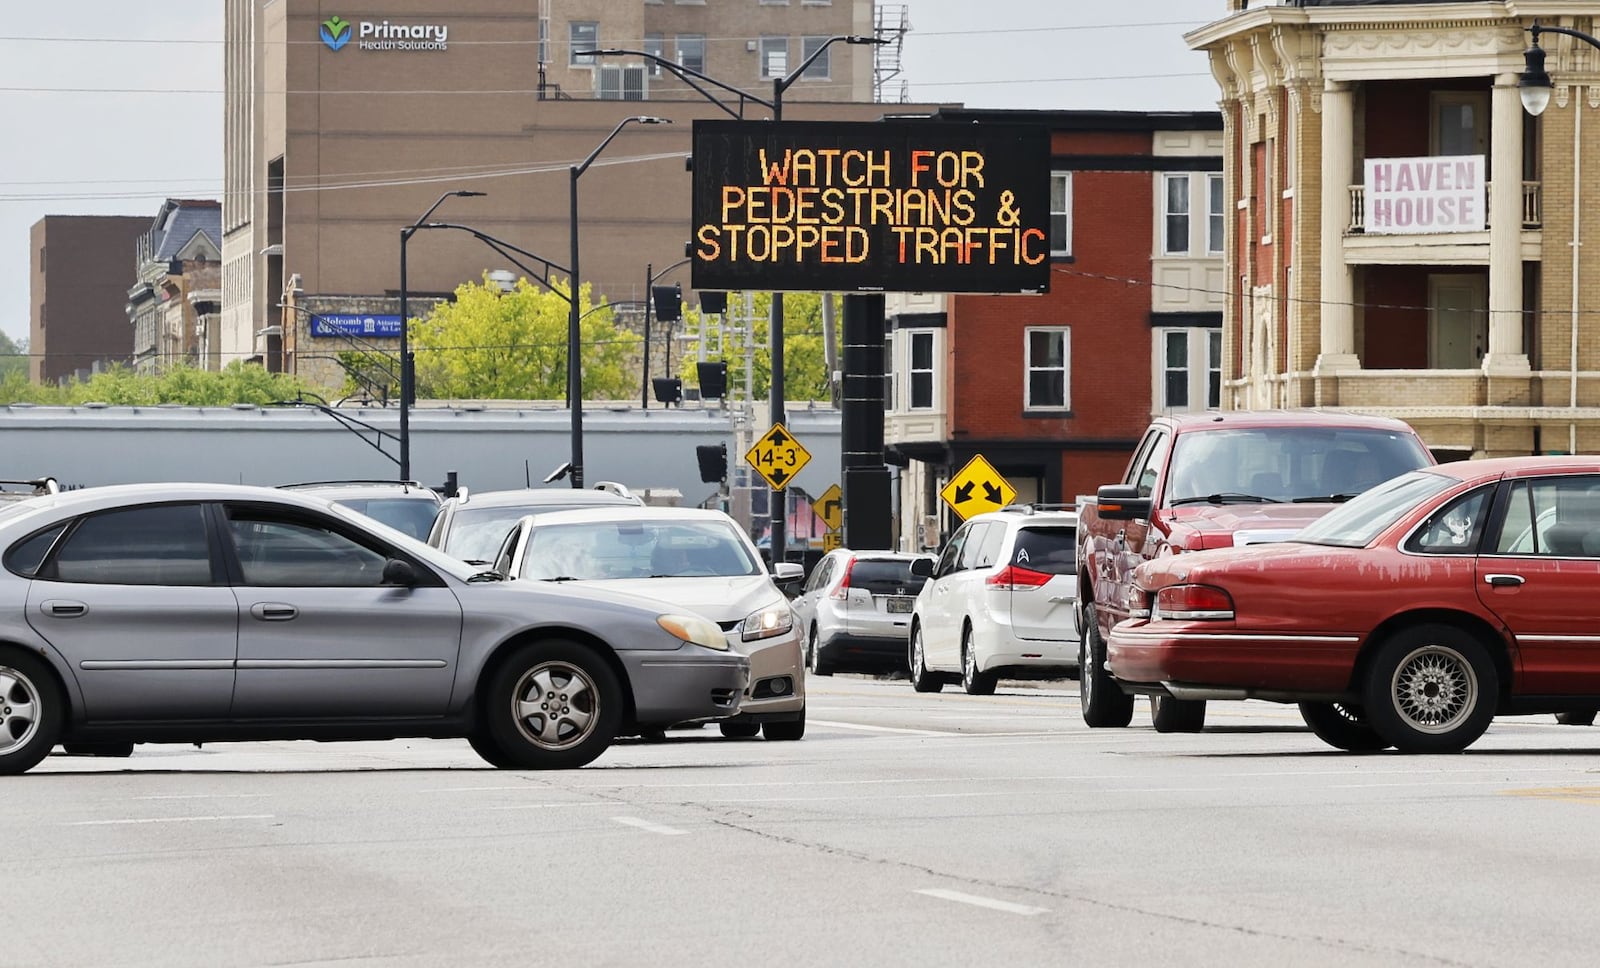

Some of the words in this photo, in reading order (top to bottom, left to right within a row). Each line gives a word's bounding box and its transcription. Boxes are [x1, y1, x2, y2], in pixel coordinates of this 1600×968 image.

[360, 21, 447, 42] Primary
[360, 40, 395, 50] Health
[398, 40, 447, 50] Solutions
[758, 148, 891, 187] WATCH
[911, 150, 985, 188] FOR
[1374, 161, 1475, 192] HAVEN
[721, 186, 976, 226] PEDESTRIANS
[996, 189, 1021, 227] &
[1374, 196, 1475, 227] HOUSE
[697, 224, 870, 263] STOPPED
[891, 226, 1046, 265] TRAFFIC
